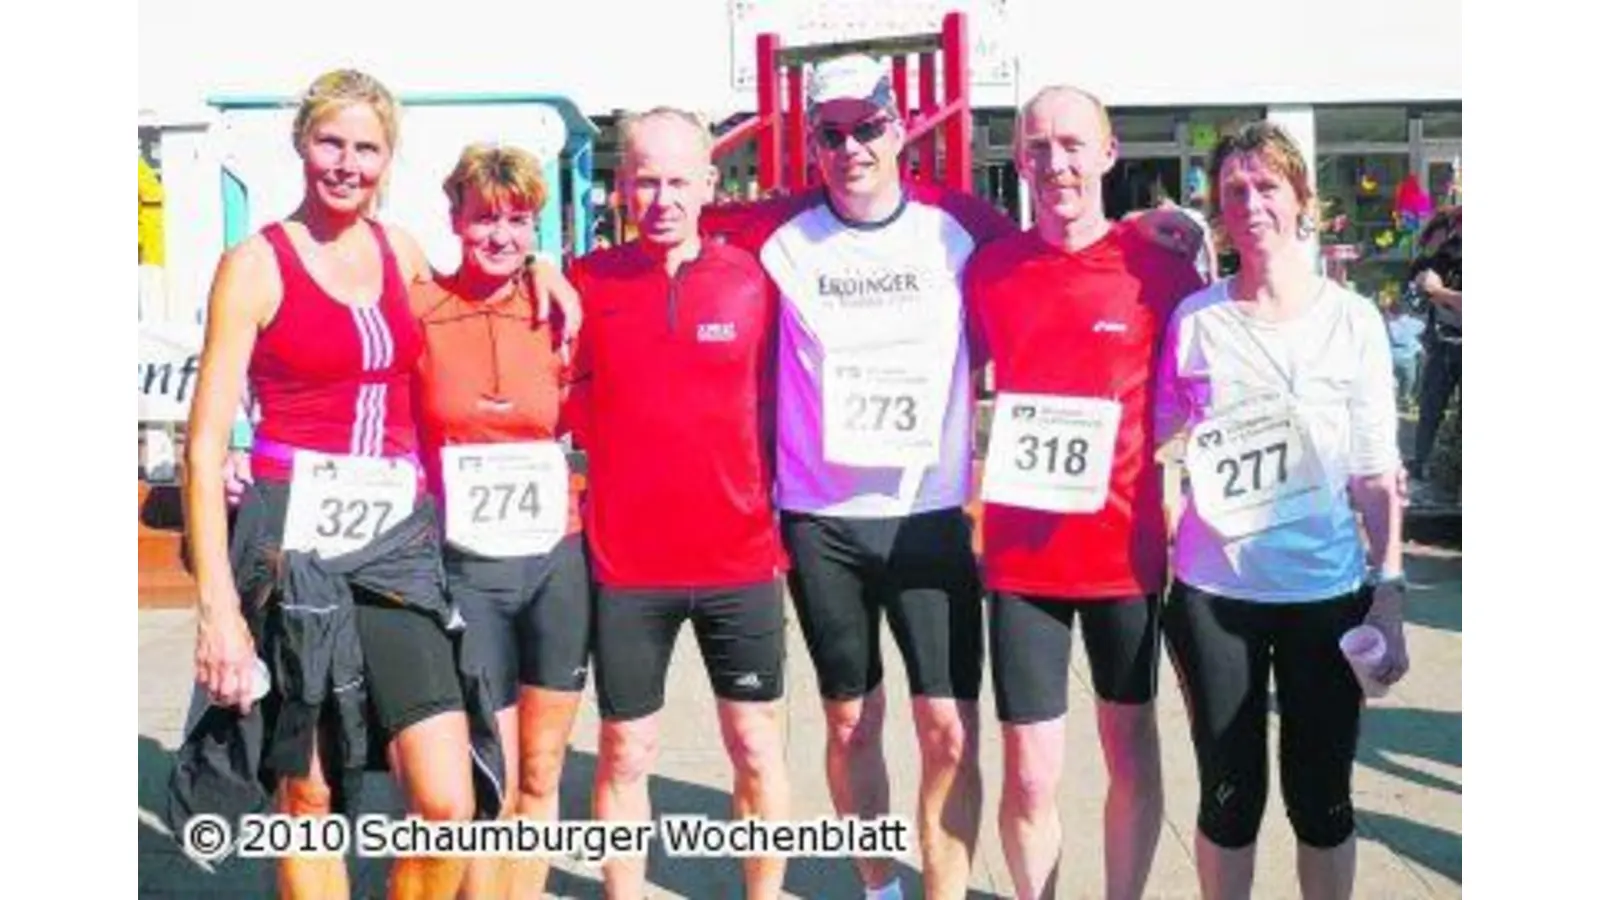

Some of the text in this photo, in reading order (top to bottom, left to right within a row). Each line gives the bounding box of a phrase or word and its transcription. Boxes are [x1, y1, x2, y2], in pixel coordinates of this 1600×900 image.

[818, 273, 920, 296] ERDINGER
[845, 394, 918, 432] 273
[1015, 434, 1090, 477] 318
[1216, 442, 1288, 498] 277
[316, 497, 394, 540] 327
[468, 481, 542, 523] 274
